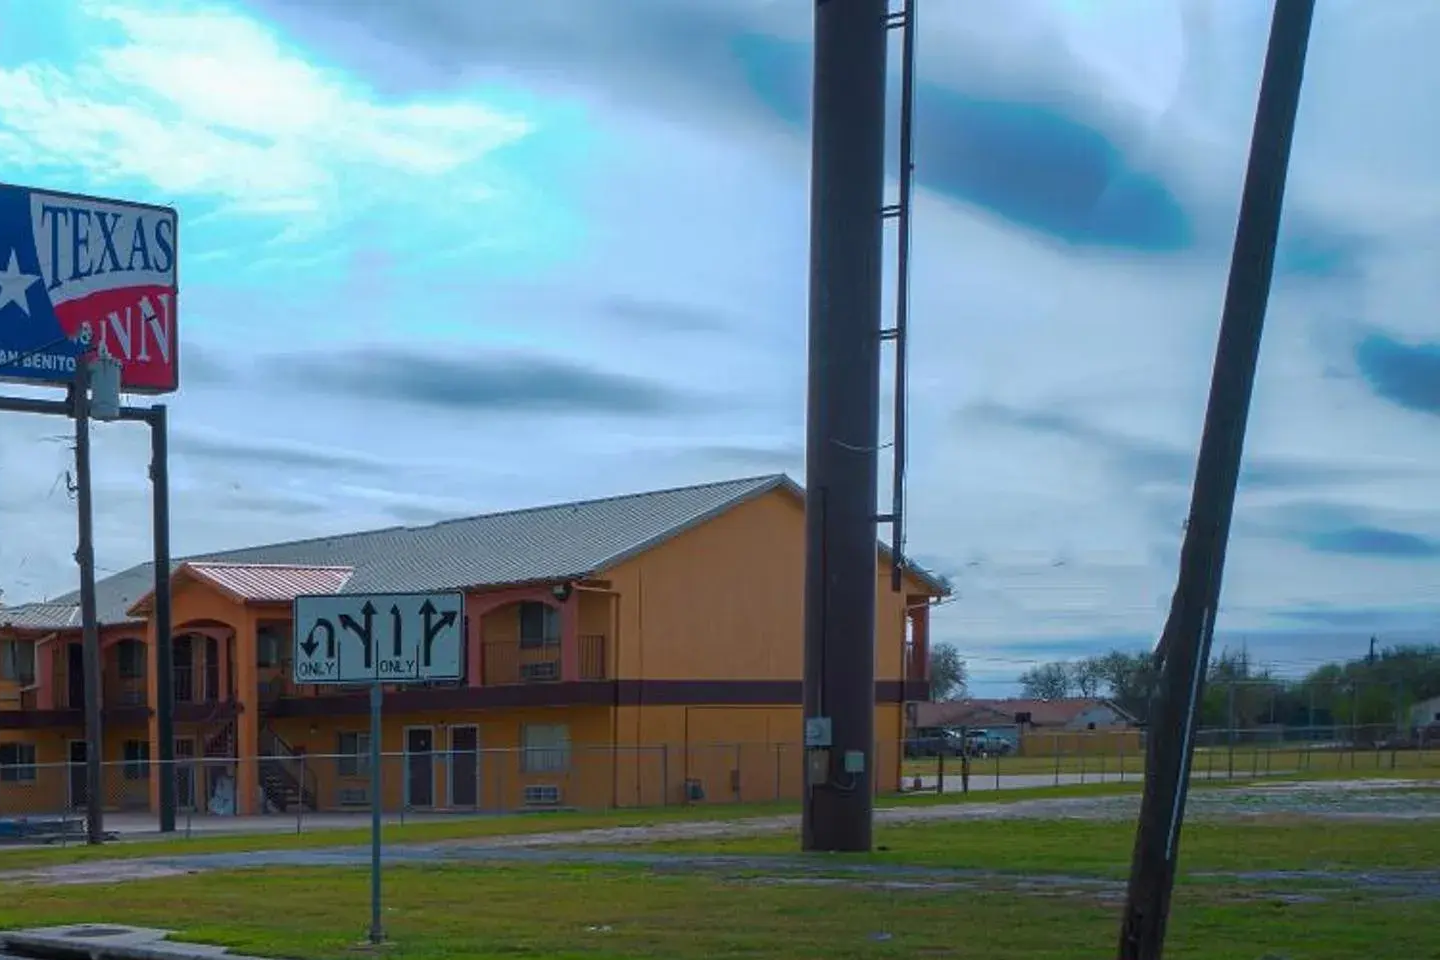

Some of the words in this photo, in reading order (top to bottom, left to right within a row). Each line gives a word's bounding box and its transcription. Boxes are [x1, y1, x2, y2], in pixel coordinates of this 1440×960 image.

[41, 203, 173, 289] TEXAS
[98, 293, 172, 365] INN
[22, 352, 77, 372] BENITO
[298, 662, 335, 677] ONLY
[379, 660, 416, 673] ONLY
